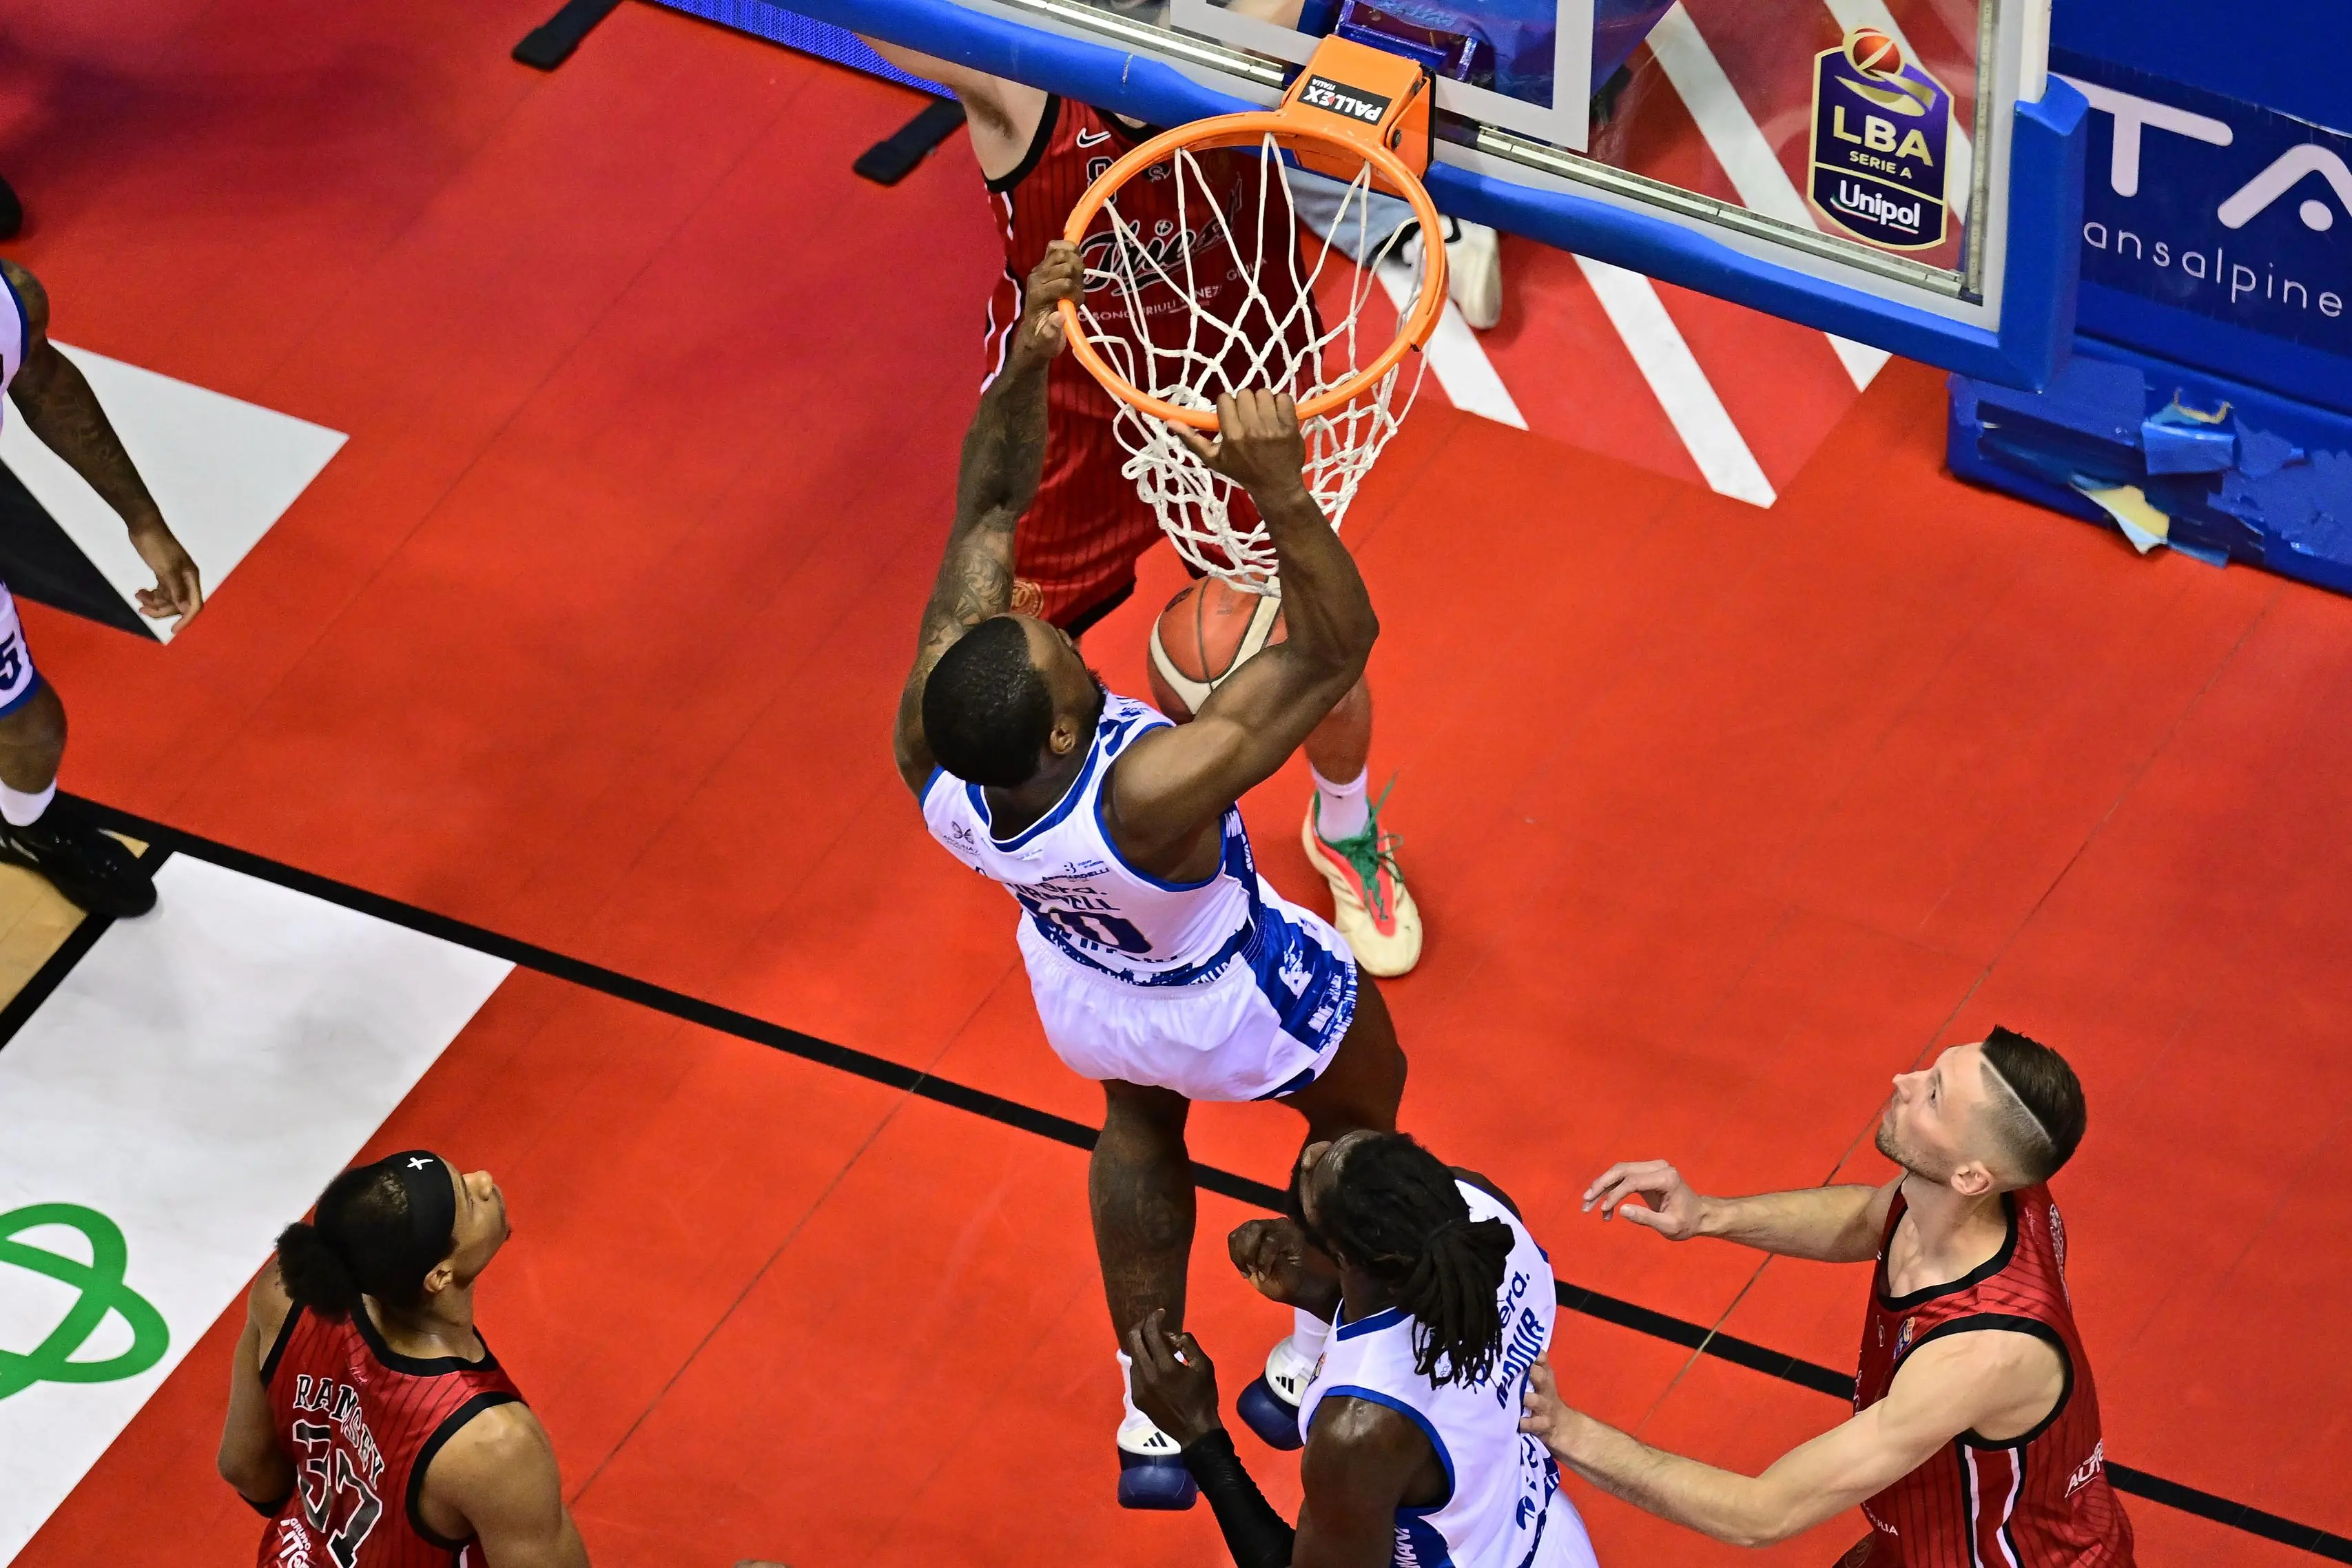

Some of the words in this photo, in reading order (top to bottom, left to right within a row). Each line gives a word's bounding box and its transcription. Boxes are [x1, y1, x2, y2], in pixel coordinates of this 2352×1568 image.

[1311, 78, 1336, 91] ITALIA
[1303, 85, 1383, 121] PALLEX
[1833, 105, 1934, 167] LBA
[1849, 150, 1897, 174] SERIE
[1899, 167, 1912, 179] A
[1839, 180, 1921, 227] Unipol
[2083, 221, 2342, 318] ansalpine
[1139, 300, 1177, 316] RIULI
[293, 1374, 385, 1491] RAMSEY
[290, 1518, 311, 1551] GRUPPO
